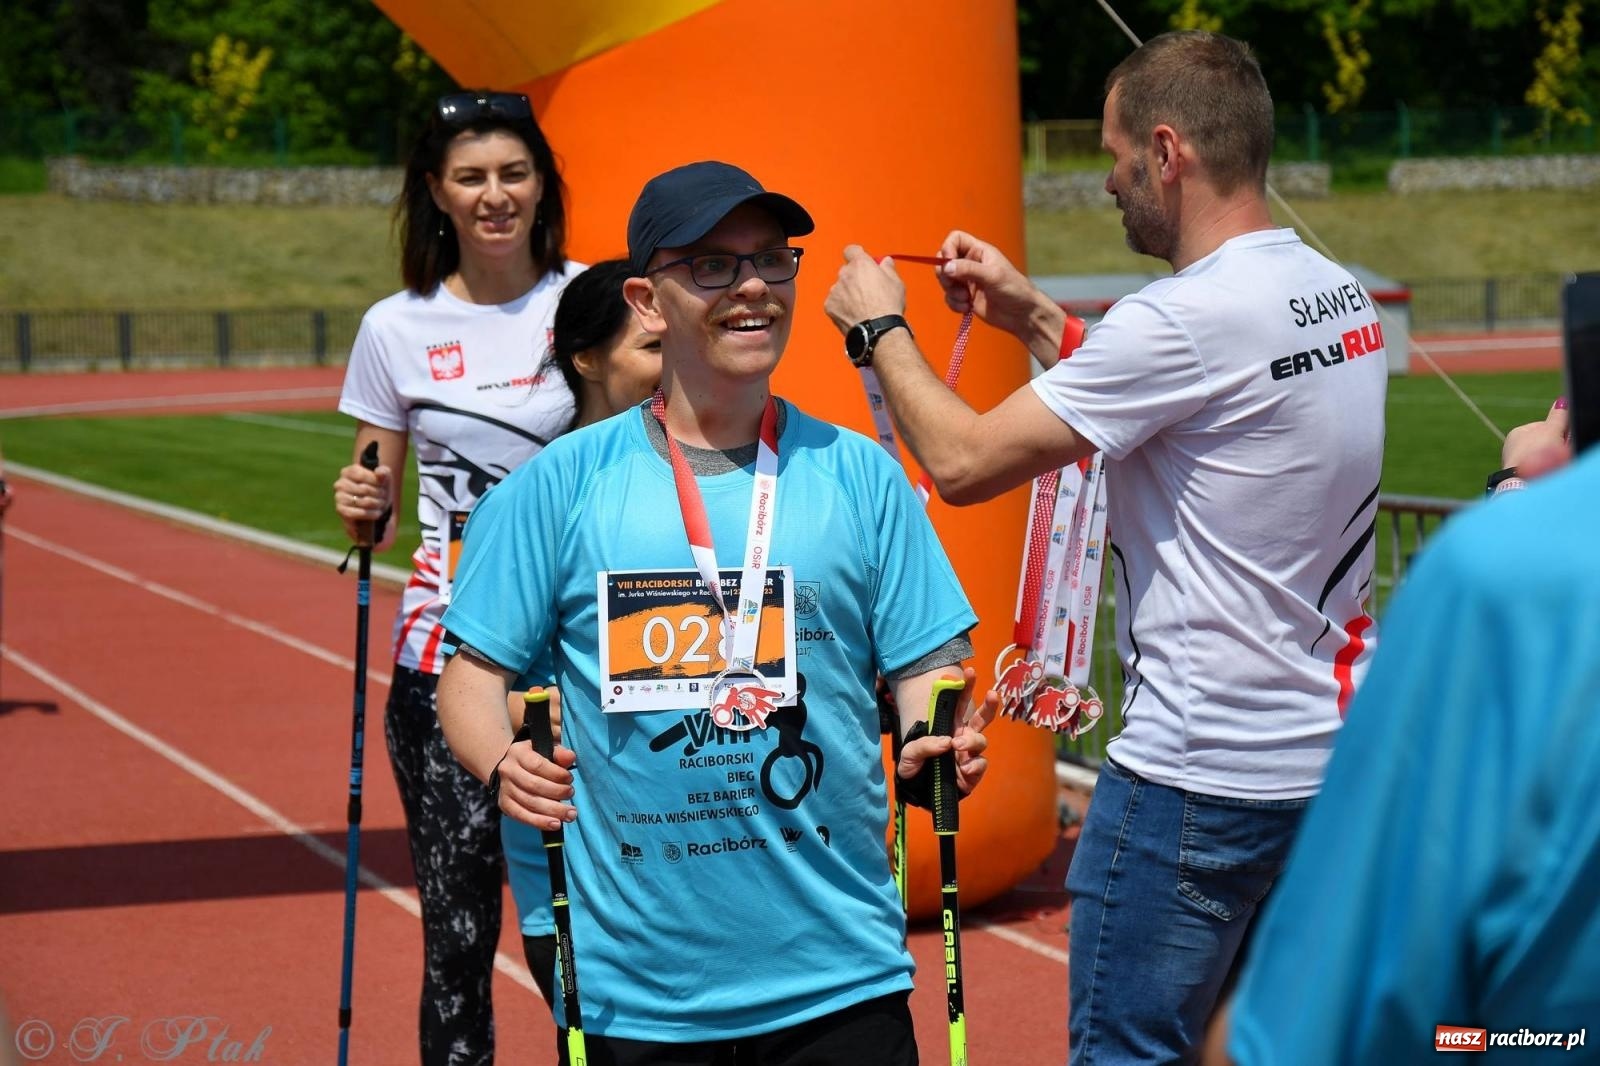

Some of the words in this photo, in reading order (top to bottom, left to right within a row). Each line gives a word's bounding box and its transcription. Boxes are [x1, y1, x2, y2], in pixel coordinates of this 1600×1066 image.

[1289, 281, 1370, 327] SŁAWEK
[755, 492, 769, 536] Racibórz
[617, 581, 633, 589] VIII
[635, 579, 693, 589] RACIBORSKI
[720, 578, 738, 587] BEZ
[679, 752, 754, 770] RACIBORSKI
[727, 771, 755, 784] BIEG
[687, 792, 711, 804] BEZ
[713, 788, 756, 802] BARIER
[615, 811, 630, 824] im.
[631, 812, 663, 825] JURKA
[665, 804, 759, 824] WIŚNIEWSKIEGO
[687, 836, 768, 857] Racibórz
